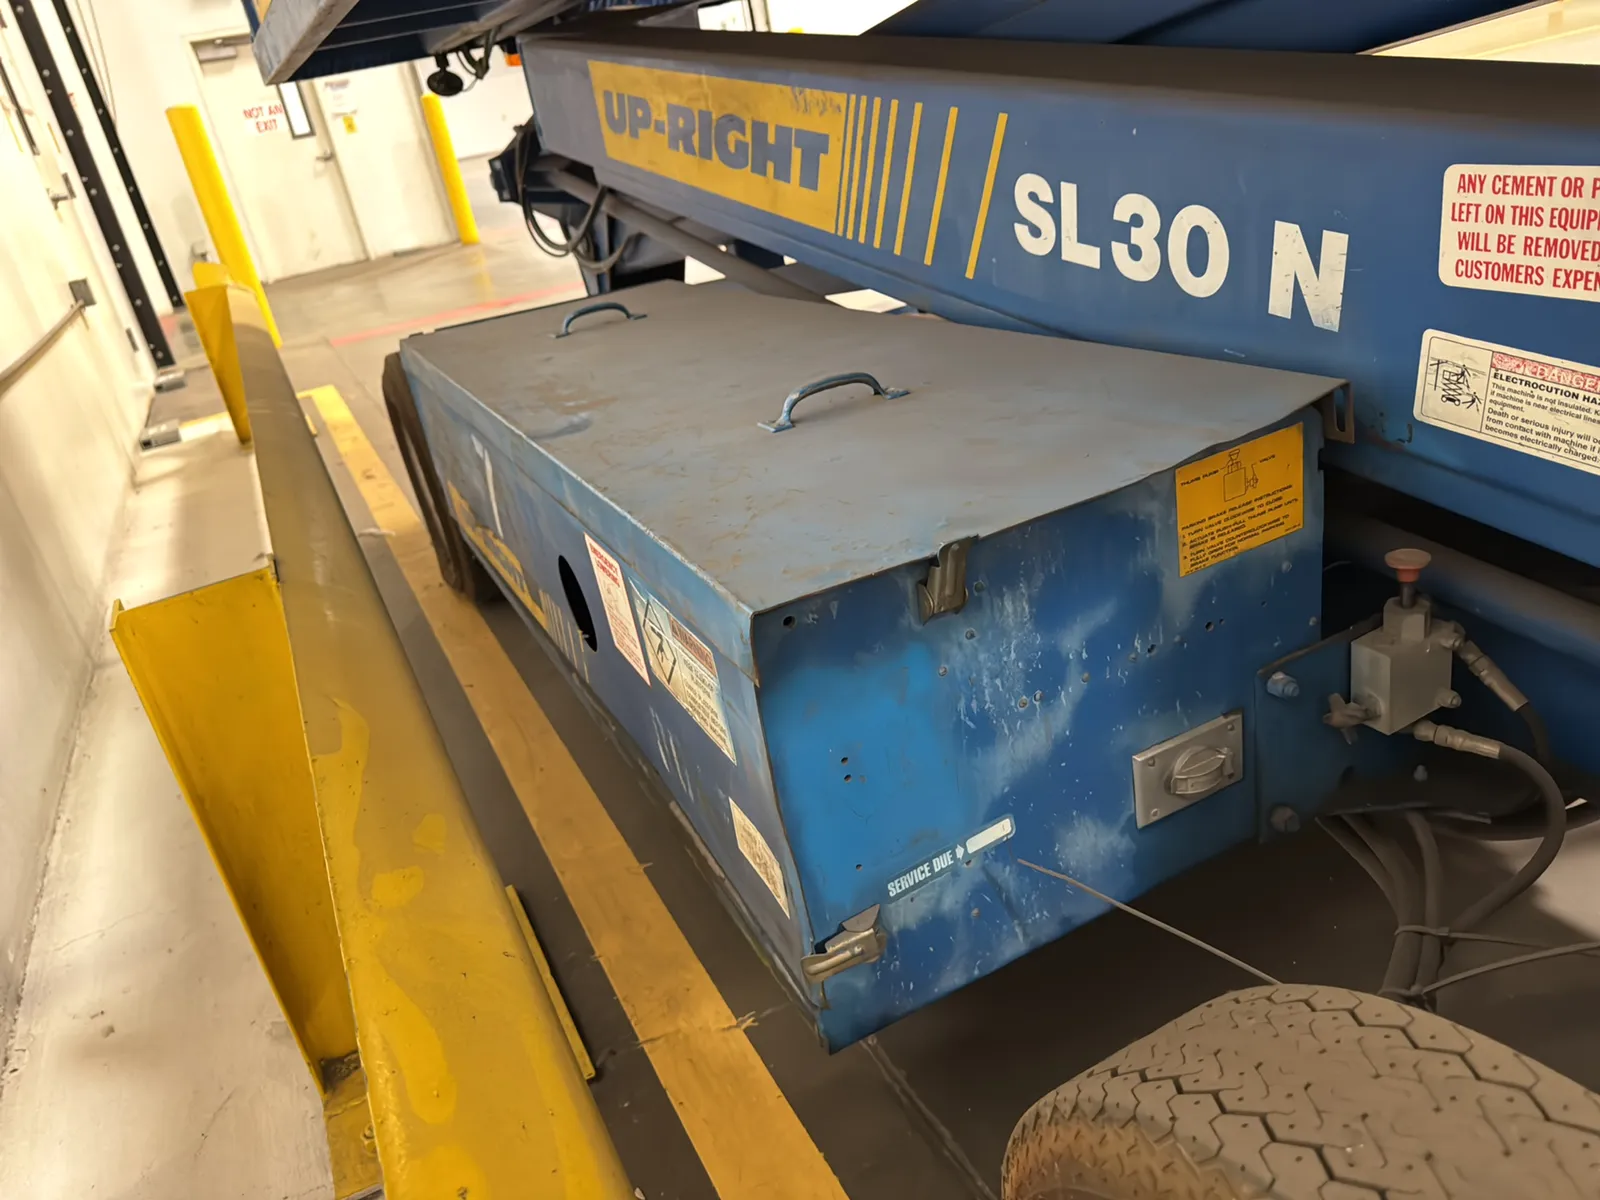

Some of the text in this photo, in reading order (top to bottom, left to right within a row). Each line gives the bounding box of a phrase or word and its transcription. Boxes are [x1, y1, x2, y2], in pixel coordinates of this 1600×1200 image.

[243, 104, 284, 120] NOT AN
[256, 119, 278, 133] EXIT
[602, 90, 829, 191] UP-RIGHT
[1457, 173, 1487, 194] ANY
[1491, 174, 1557, 197] CEMENT
[1560, 176, 1585, 198] OR
[1451, 202, 1600, 232] LEFT ON THIS EQUIP
[1013, 172, 1349, 333] SL30 N
[1457, 231, 1600, 262] WILL BE REMOVED
[1455, 258, 1544, 286] CUSTOMERS
[1493, 372, 1580, 400] ELECTROCUTION
[1537, 367, 1600, 391] DANGE
[1489, 398, 1525, 413] equipment.
[1491, 382, 1506, 391] This
[1507, 385, 1535, 399] machine
[1544, 396, 1556, 405] not
[1557, 399, 1592, 415] insulated.
[1496, 392, 1524, 404] machine
[1533, 402, 1548, 411] near
[1549, 405, 1582, 420] electrical
[1485, 424, 1518, 440] becomes
[1520, 434, 1562, 453] electrically
[1486, 415, 1504, 426] from
[1505, 422, 1534, 435] contact
[1535, 428, 1552, 440] with
[1553, 435, 1588, 451] machine
[1487, 407, 1509, 419] Death
[1511, 413, 1519, 421] or
[1520, 416, 1549, 430] serious
[1551, 424, 1575, 438] injury
[1576, 432, 1591, 442] will
[887, 850, 954, 897] SERVICE DUE
